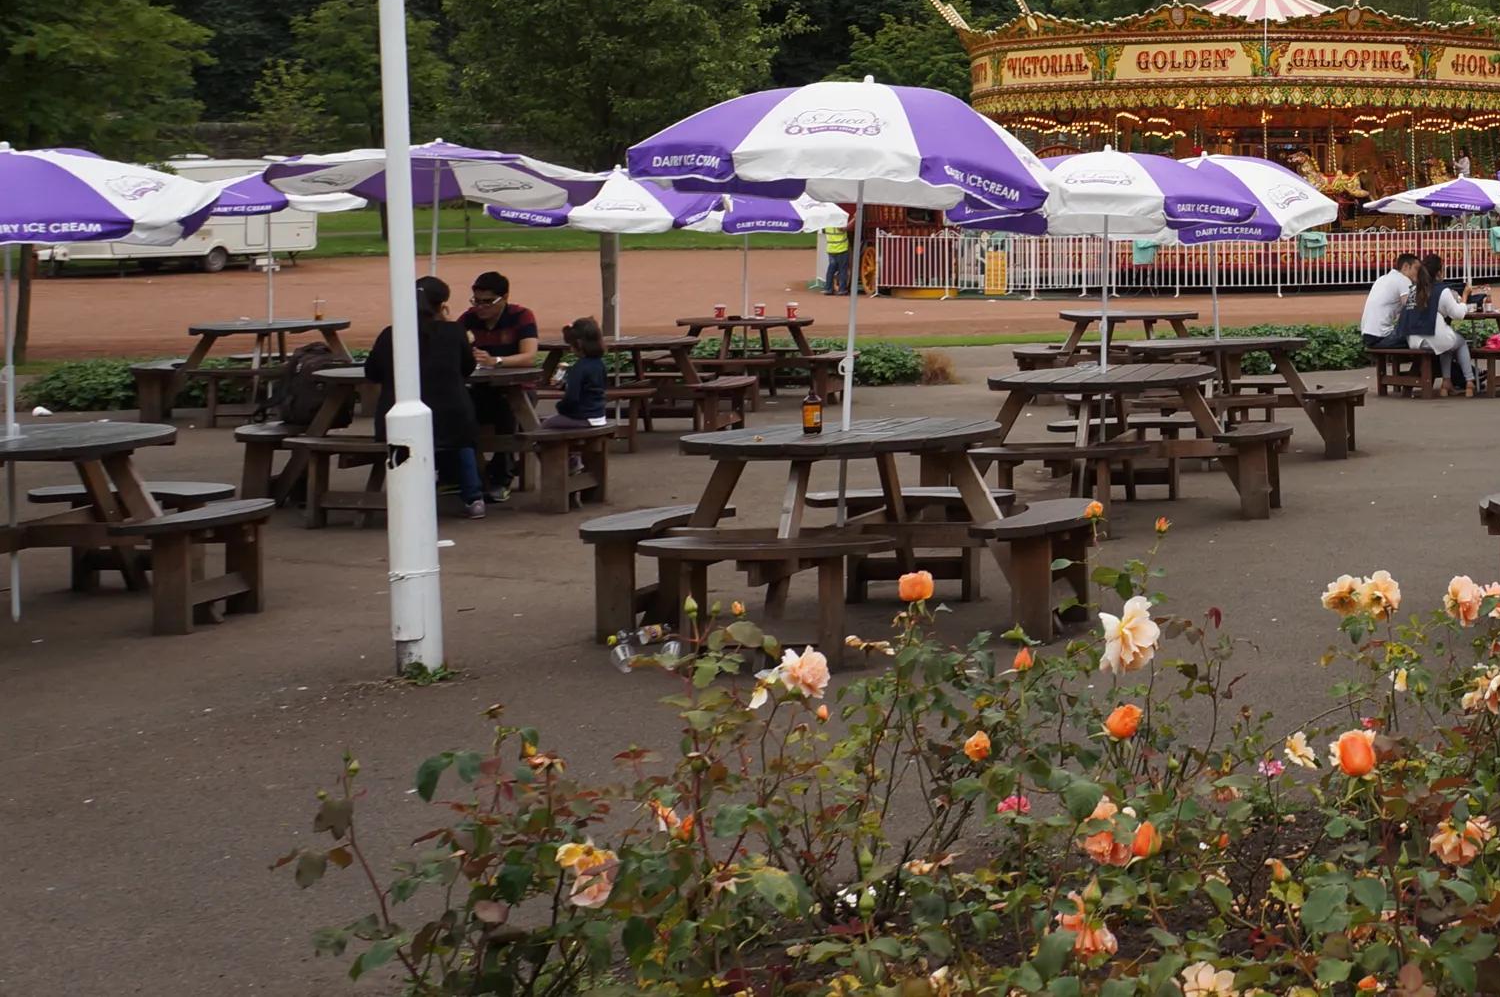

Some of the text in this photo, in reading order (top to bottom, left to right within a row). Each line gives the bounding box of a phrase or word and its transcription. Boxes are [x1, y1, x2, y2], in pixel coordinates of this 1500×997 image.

[1007, 53, 1088, 77] VICTORIAN
[1136, 49, 1236, 73] GOLDEN
[1288, 48, 1409, 74] GALLOPING
[966, 173, 982, 187] ICE
[982, 179, 1020, 202] CREAM
[1177, 203, 1239, 217] DAIRY ICE CREAM
[23, 222, 47, 233] ICE
[49, 222, 102, 233] CREAM
[1195, 226, 1262, 238] DAIRY ICE CREAM
